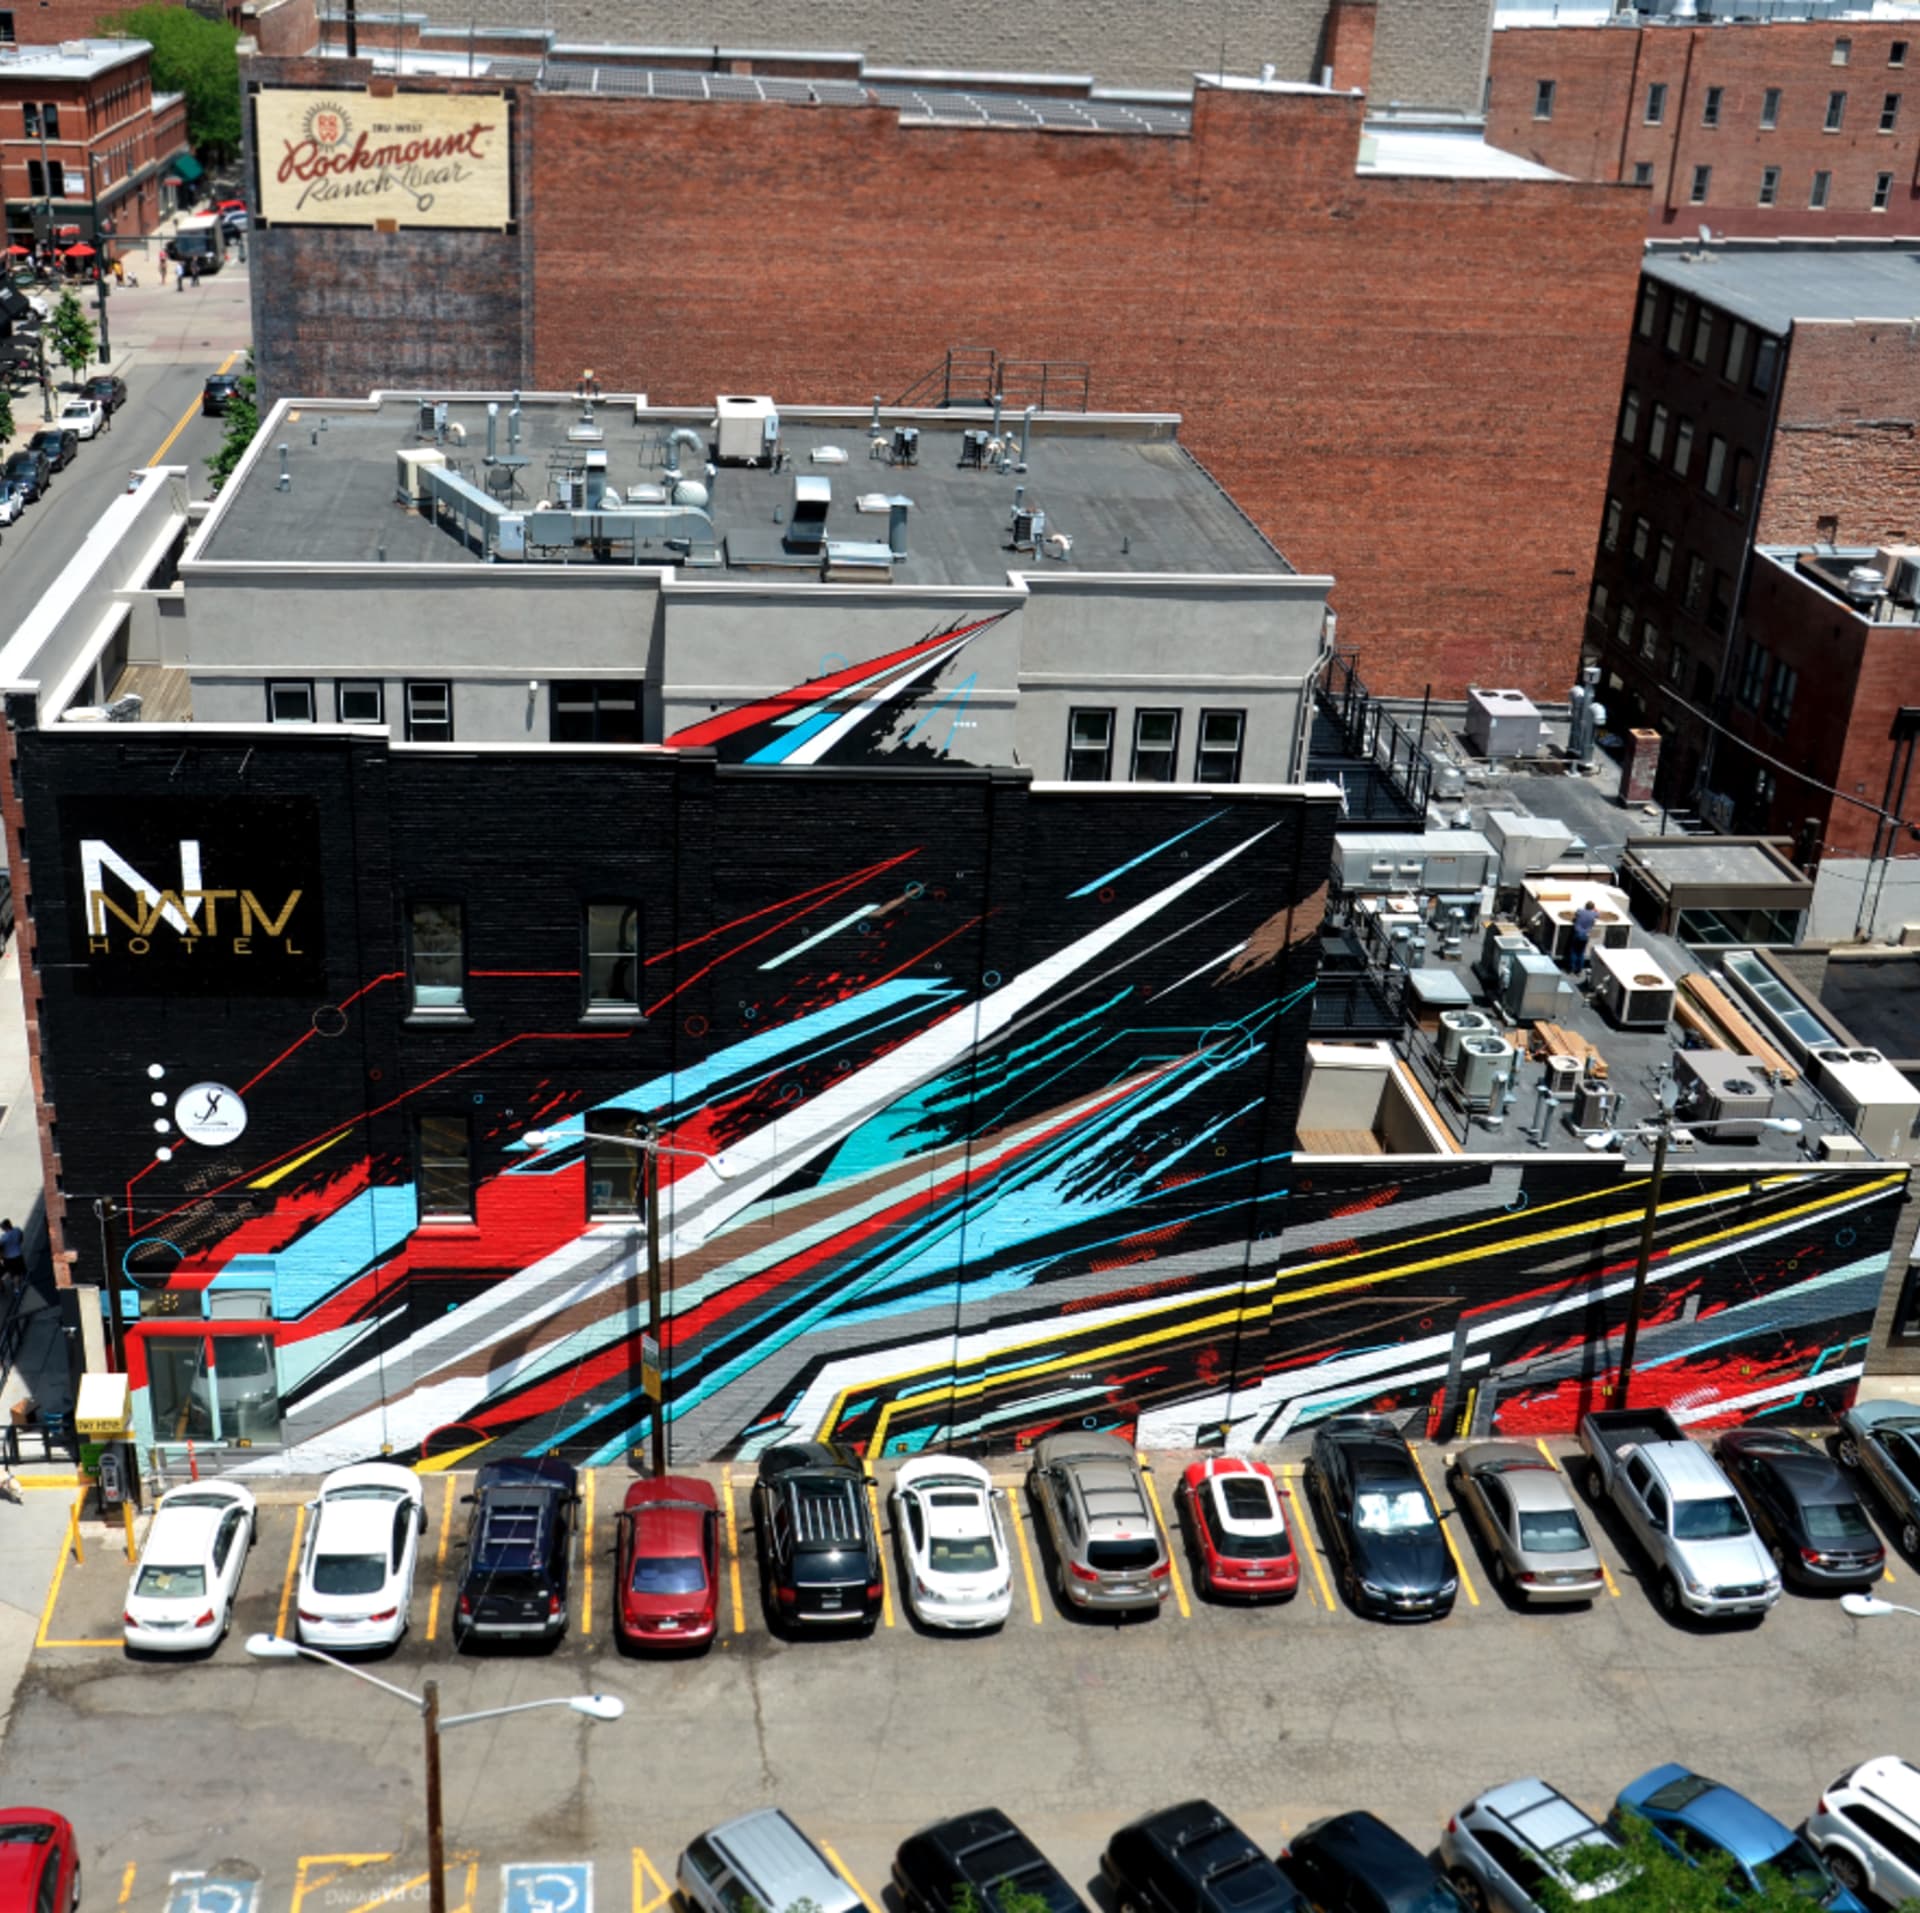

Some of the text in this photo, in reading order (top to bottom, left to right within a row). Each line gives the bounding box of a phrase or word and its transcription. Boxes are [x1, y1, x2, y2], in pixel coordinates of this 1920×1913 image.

[277, 122, 496, 184] Rockmount
[296, 162, 473, 210] Ranch Wear
[89, 938, 303, 954] HOTEL
